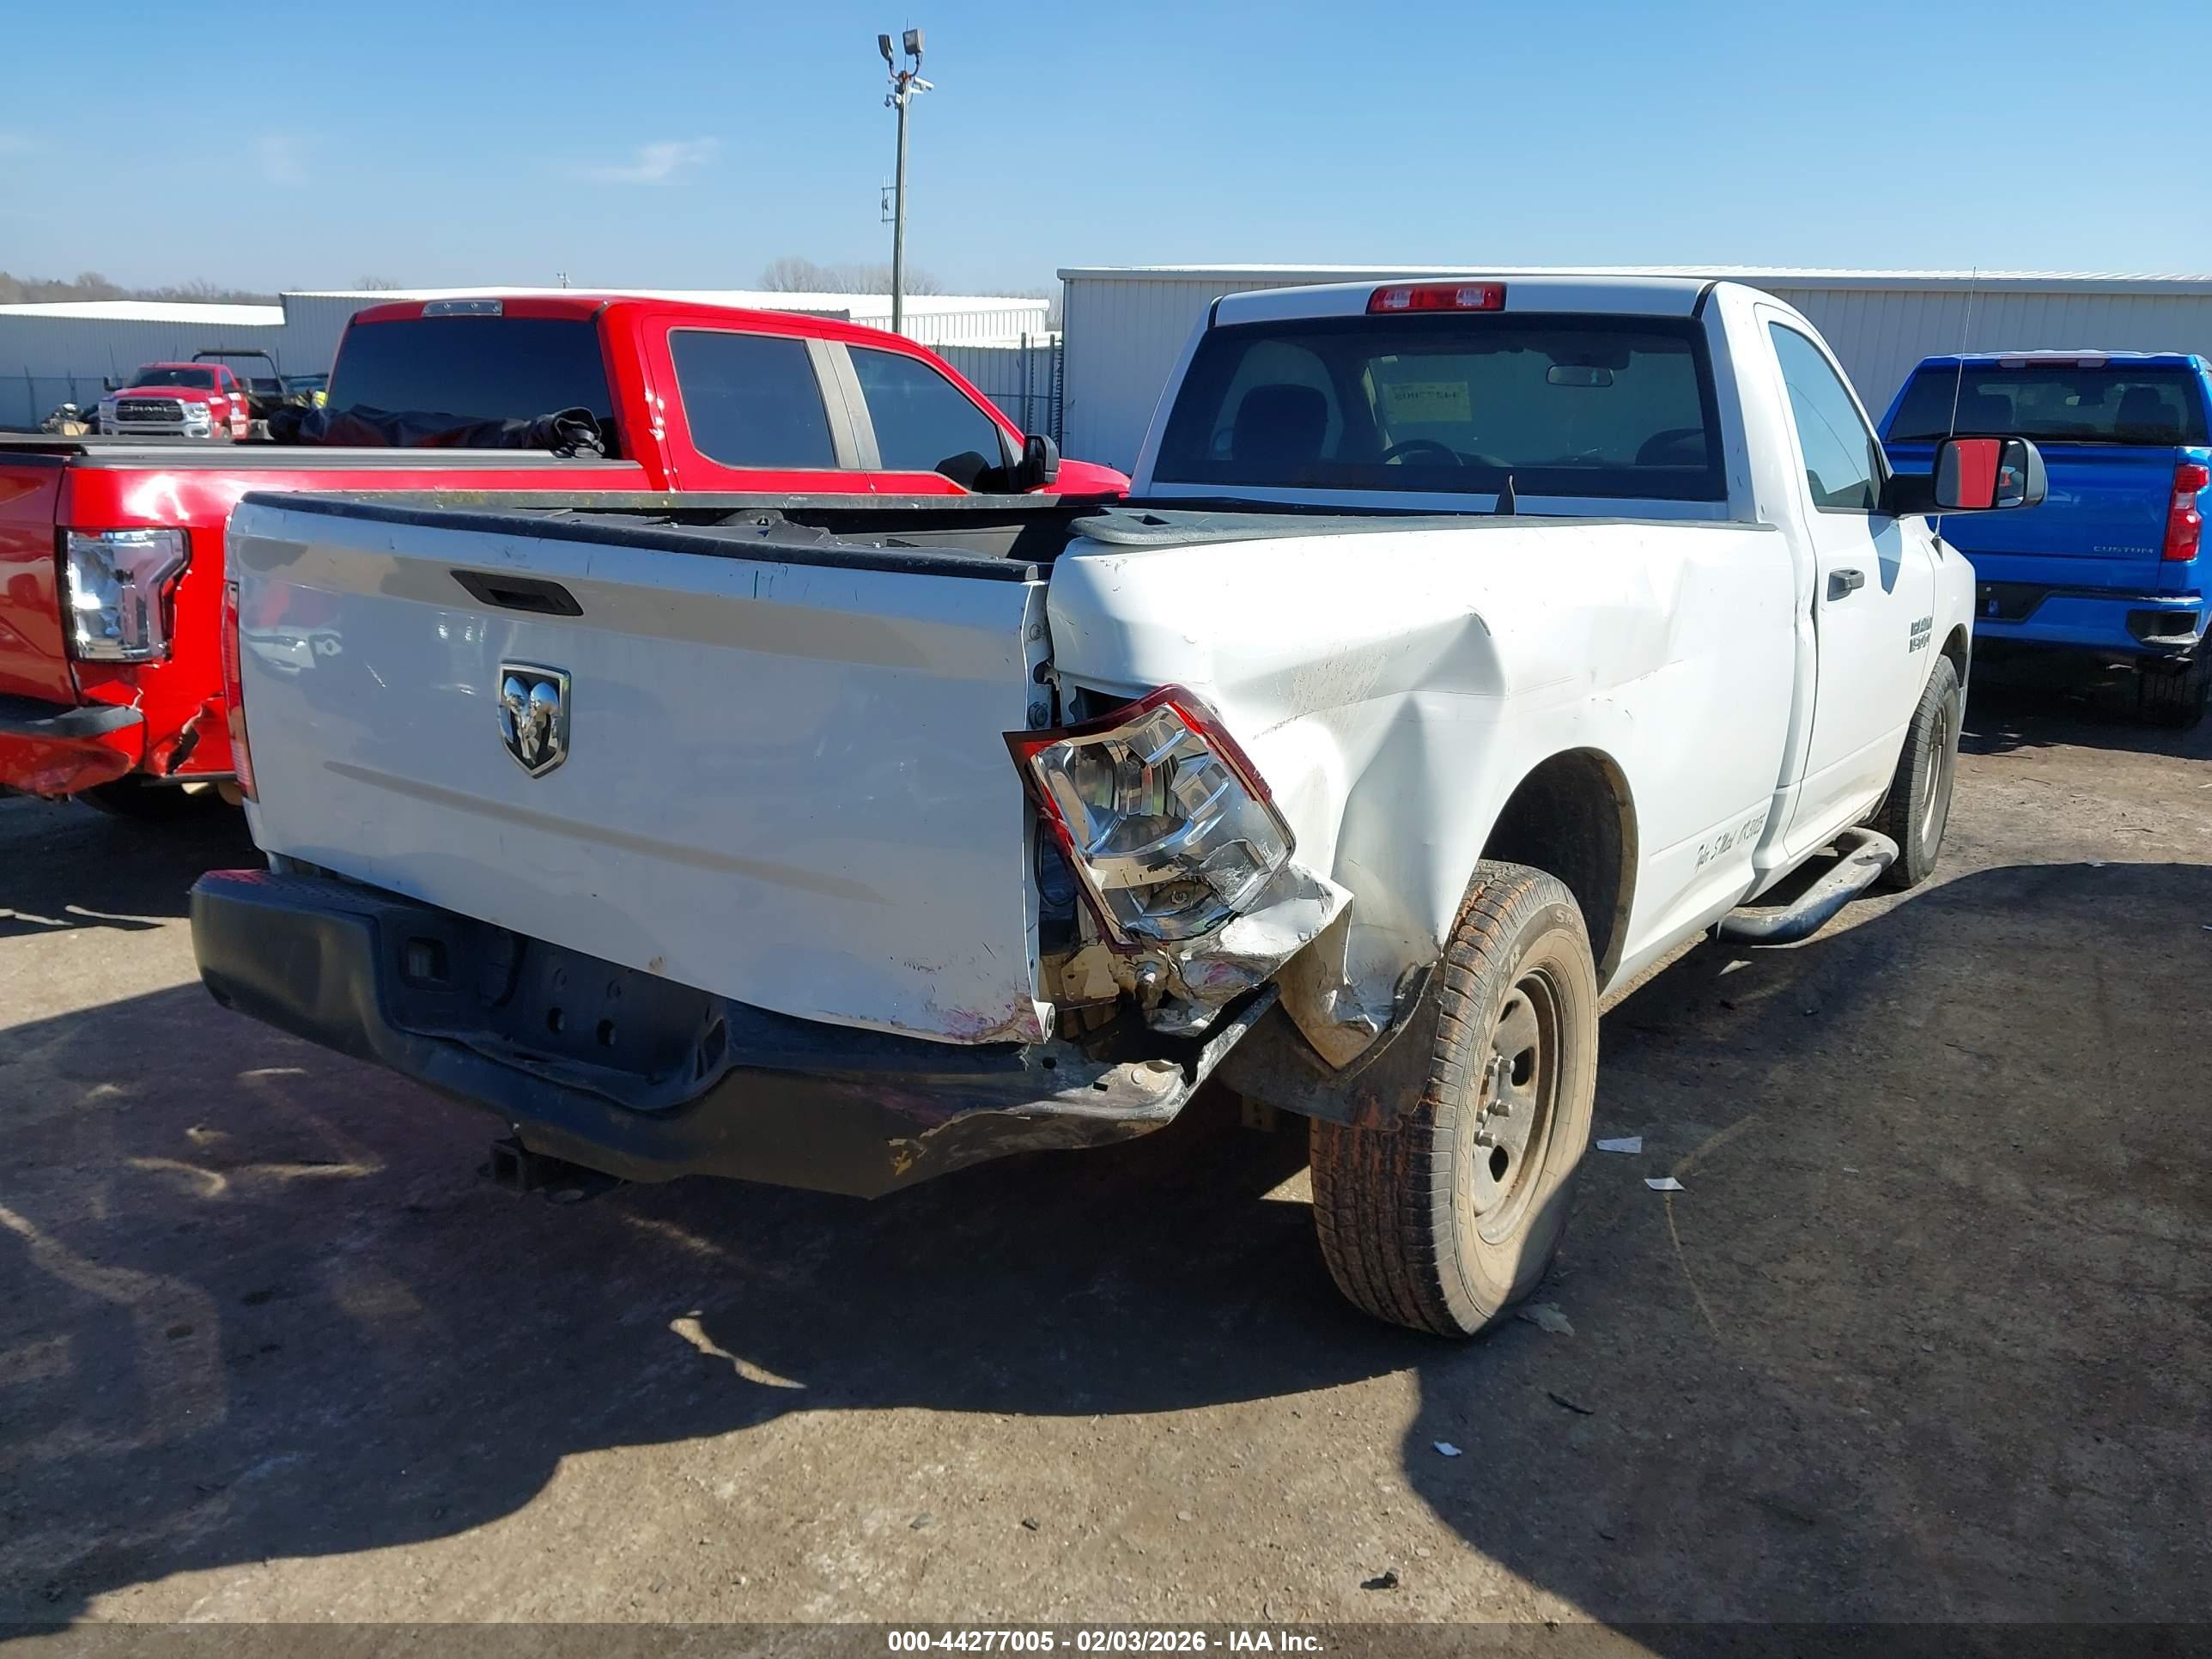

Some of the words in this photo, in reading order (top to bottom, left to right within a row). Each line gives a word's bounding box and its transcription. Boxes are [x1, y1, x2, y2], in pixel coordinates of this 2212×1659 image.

[2093, 544, 2154, 555] CUSTOM
[1911, 617, 1933, 636] RAM
[1909, 632, 1931, 653] 1500
